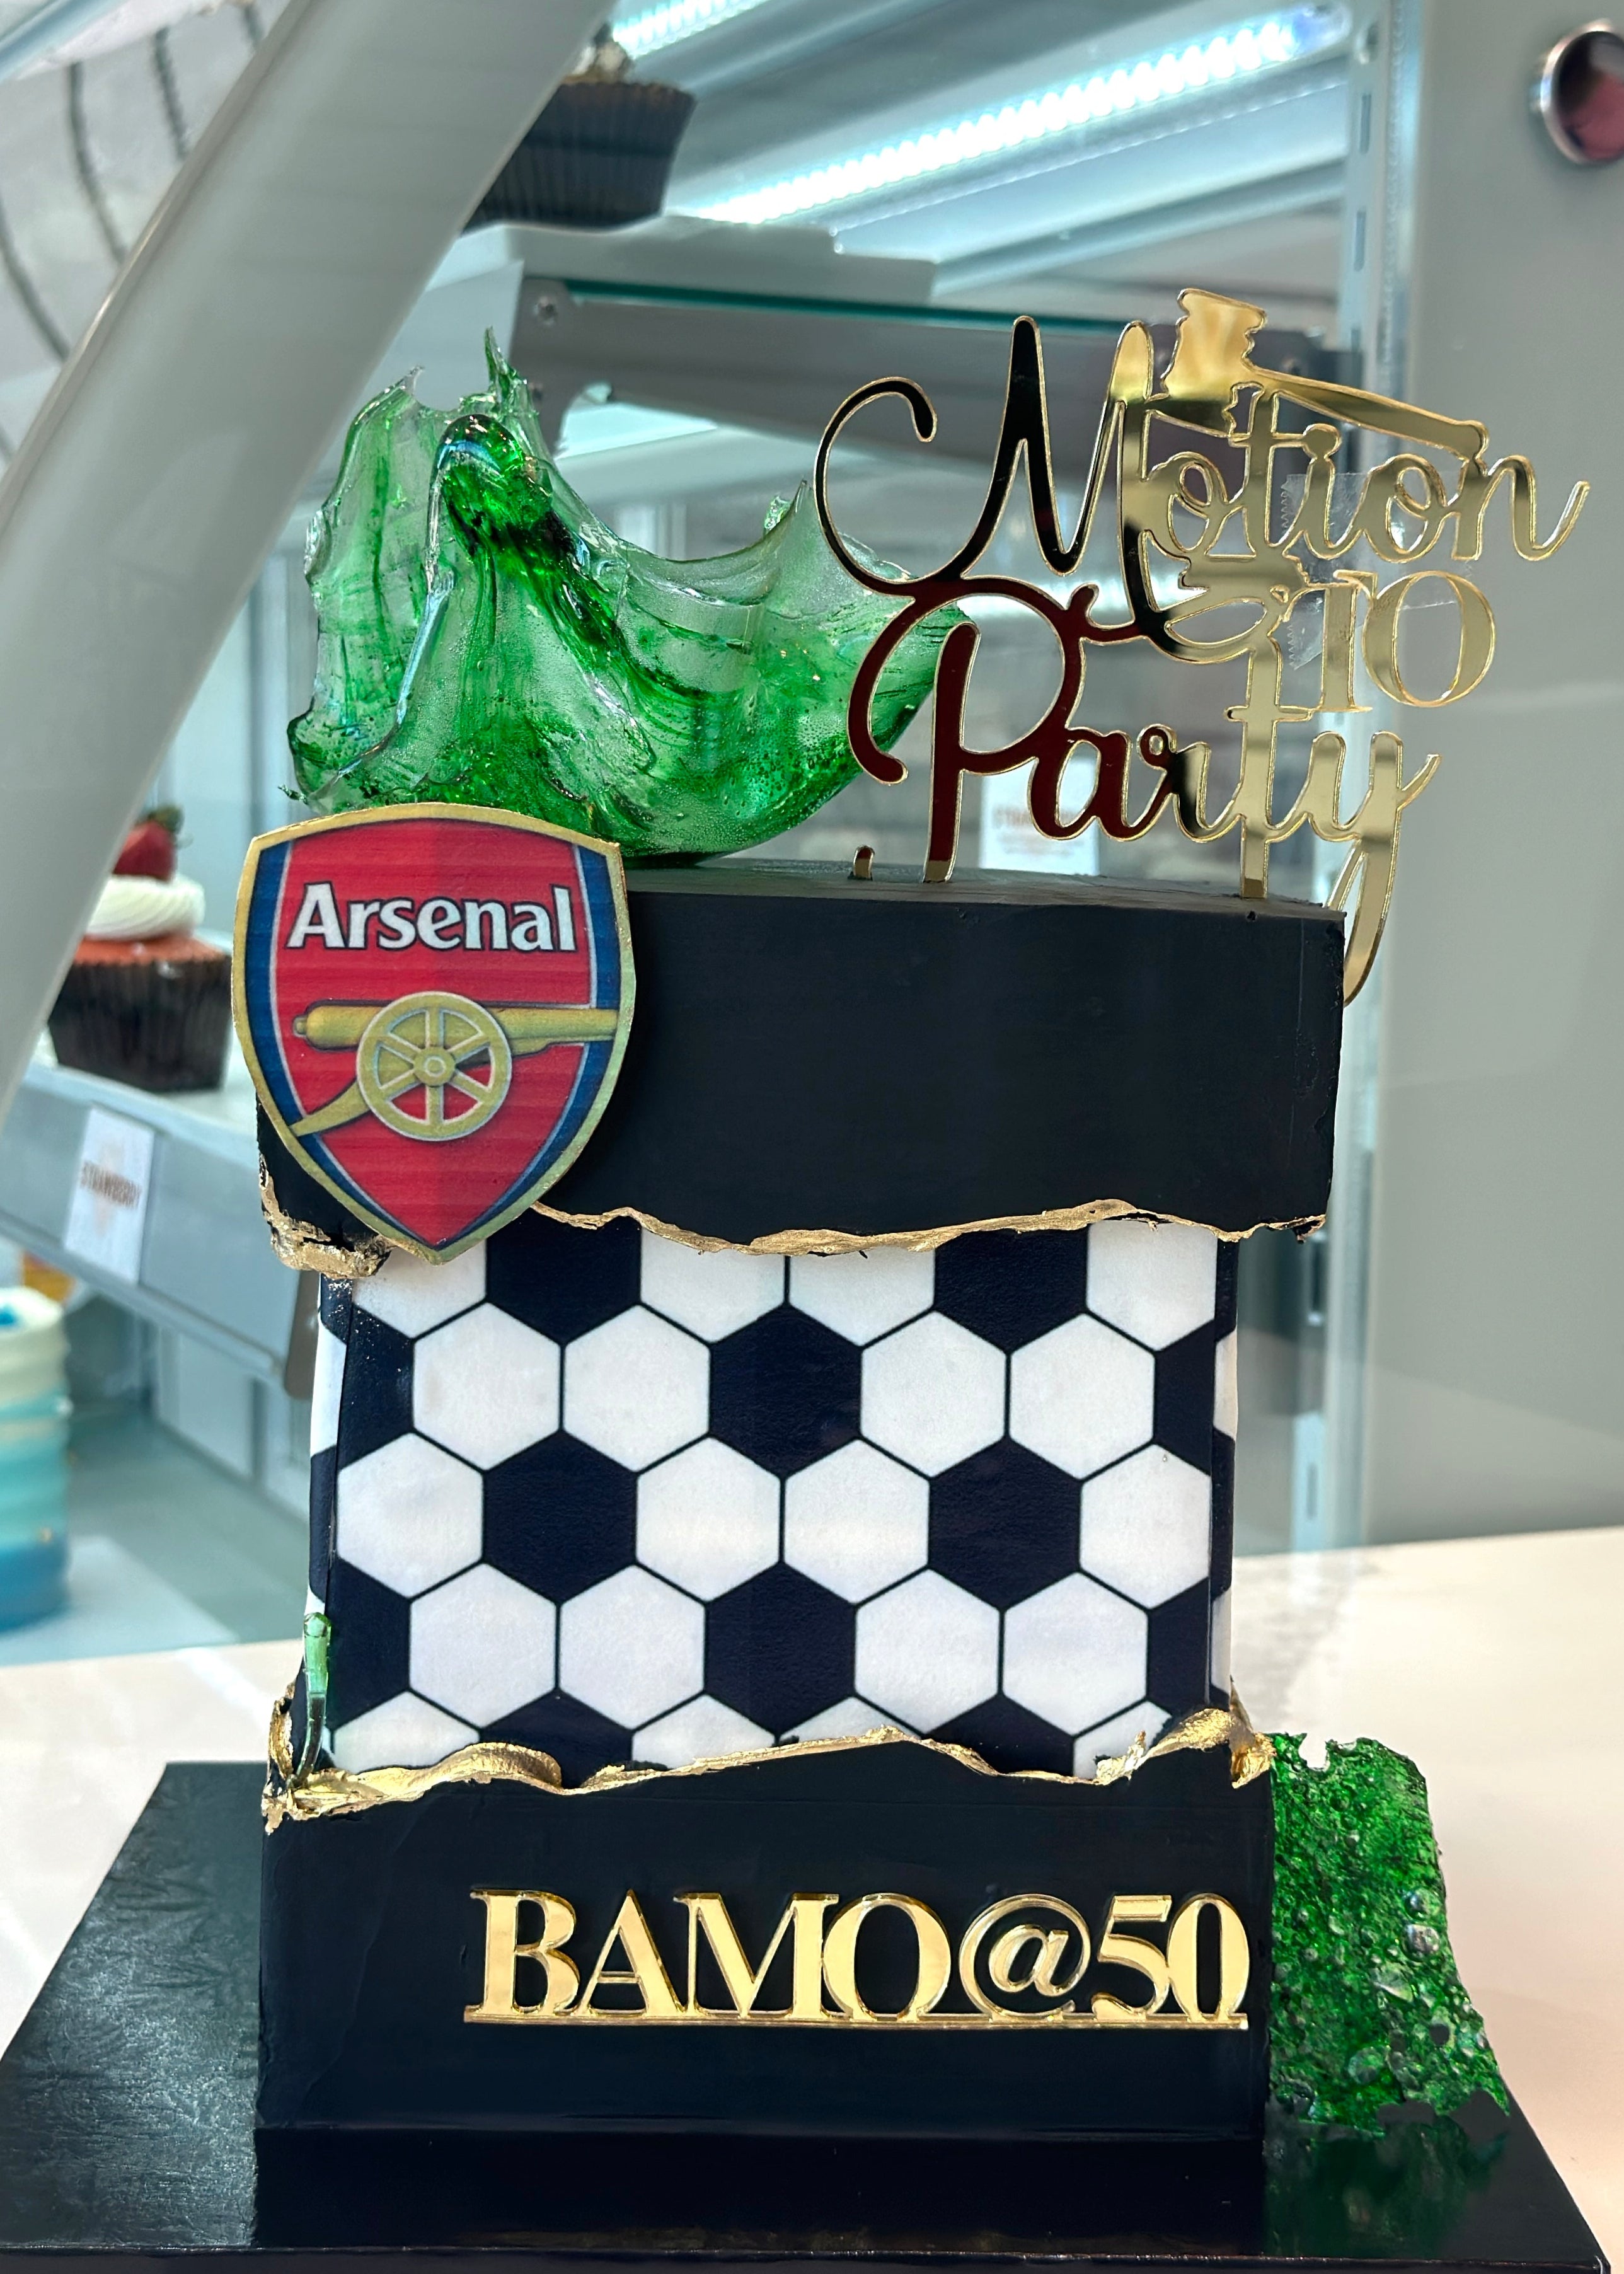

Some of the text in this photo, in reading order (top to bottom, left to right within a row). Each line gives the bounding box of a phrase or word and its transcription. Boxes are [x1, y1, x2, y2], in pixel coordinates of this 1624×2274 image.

[814, 316, 1591, 621] Motion
[848, 575, 1441, 1008] Party
[285, 880, 578, 952] Arsenal
[464, 1889, 1251, 2028] BAMO@50
